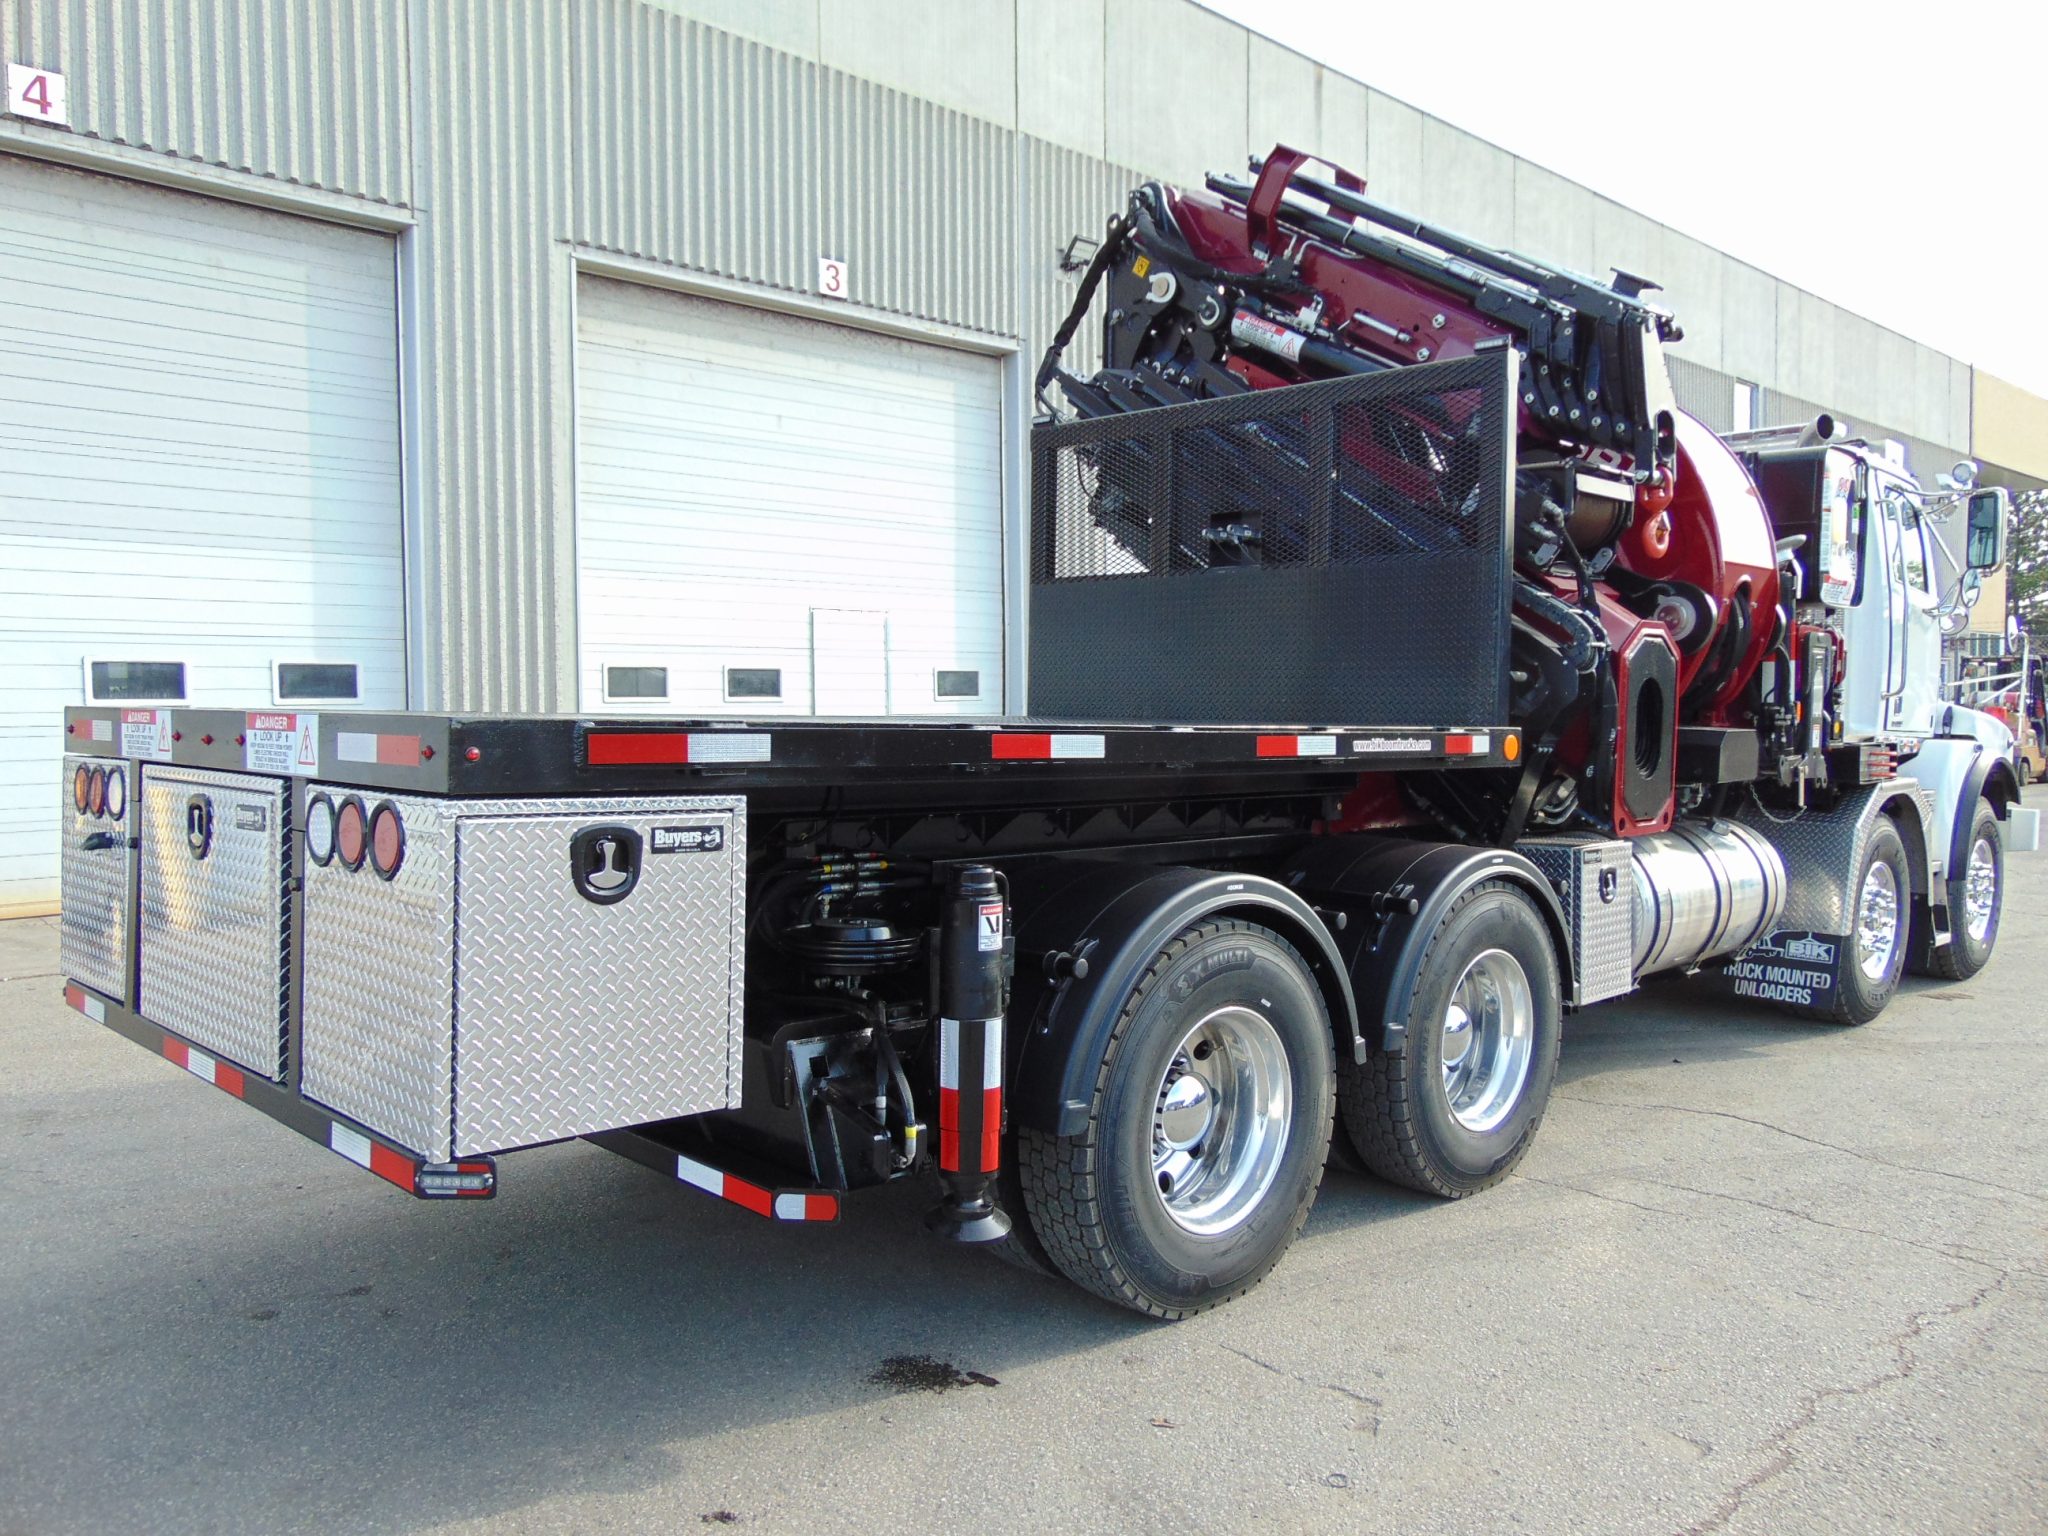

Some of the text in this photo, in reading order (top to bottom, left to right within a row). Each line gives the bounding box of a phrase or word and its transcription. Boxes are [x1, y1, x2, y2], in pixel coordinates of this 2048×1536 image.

[22, 75, 53, 115] 4
[826, 264, 840, 292] 3
[259, 715, 288, 730] DANGER
[259, 731, 283, 743] LOOK UP
[654, 829, 703, 847] Buyers
[1207, 950, 1248, 970] MULTI
[1789, 942, 1831, 959] BIK
[1766, 965, 1831, 989] MOUNTED
[1734, 978, 1812, 1005] UNLOADERS
